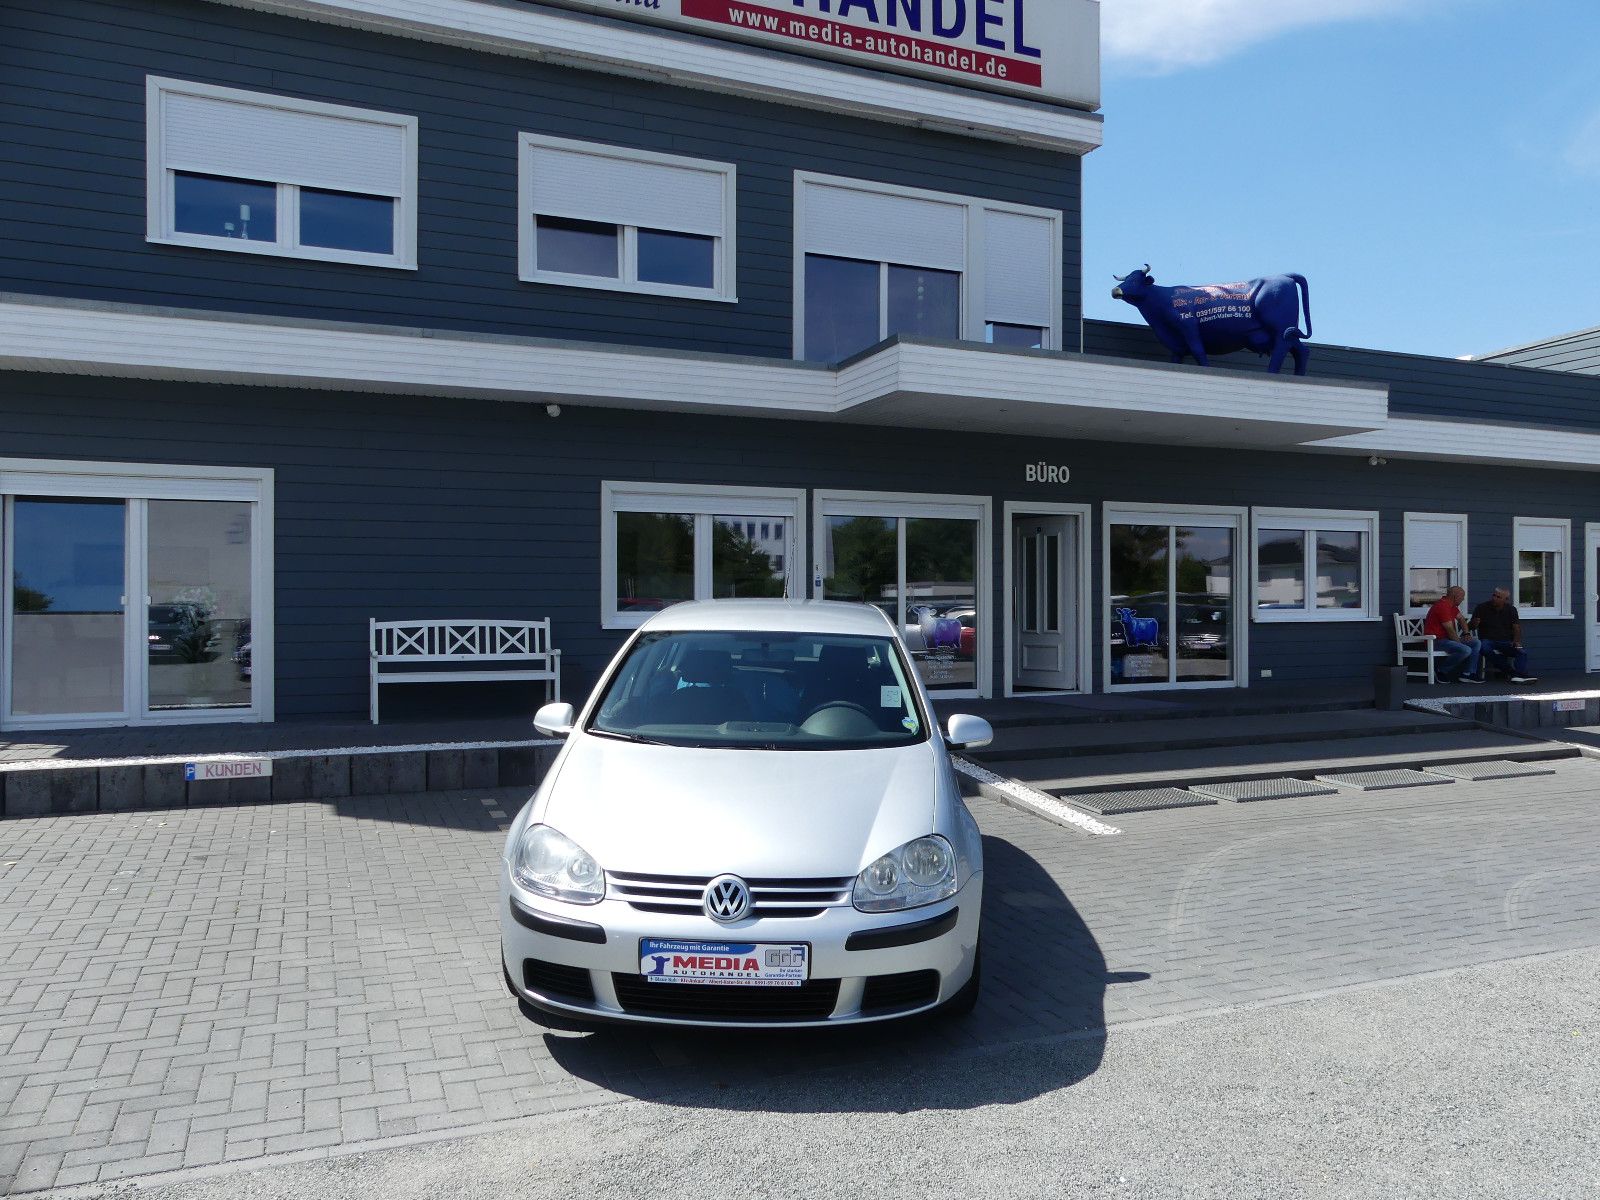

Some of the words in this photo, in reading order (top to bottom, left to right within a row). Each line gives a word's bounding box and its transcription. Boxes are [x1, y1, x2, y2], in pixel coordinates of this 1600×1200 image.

[792, 0, 1042, 59] NDEL
[728, 7, 1008, 78] www.media-autohandel.de
[1180, 311, 1194, 320] Tel.
[1025, 462, 1070, 483] BÜRO
[205, 762, 262, 778] KUNDEN
[659, 942, 689, 951] Fahrzeug
[701, 944, 730, 952] Garantie
[673, 955, 760, 971] MEDIA
[673, 969, 760, 978] AUTOHANDEL
